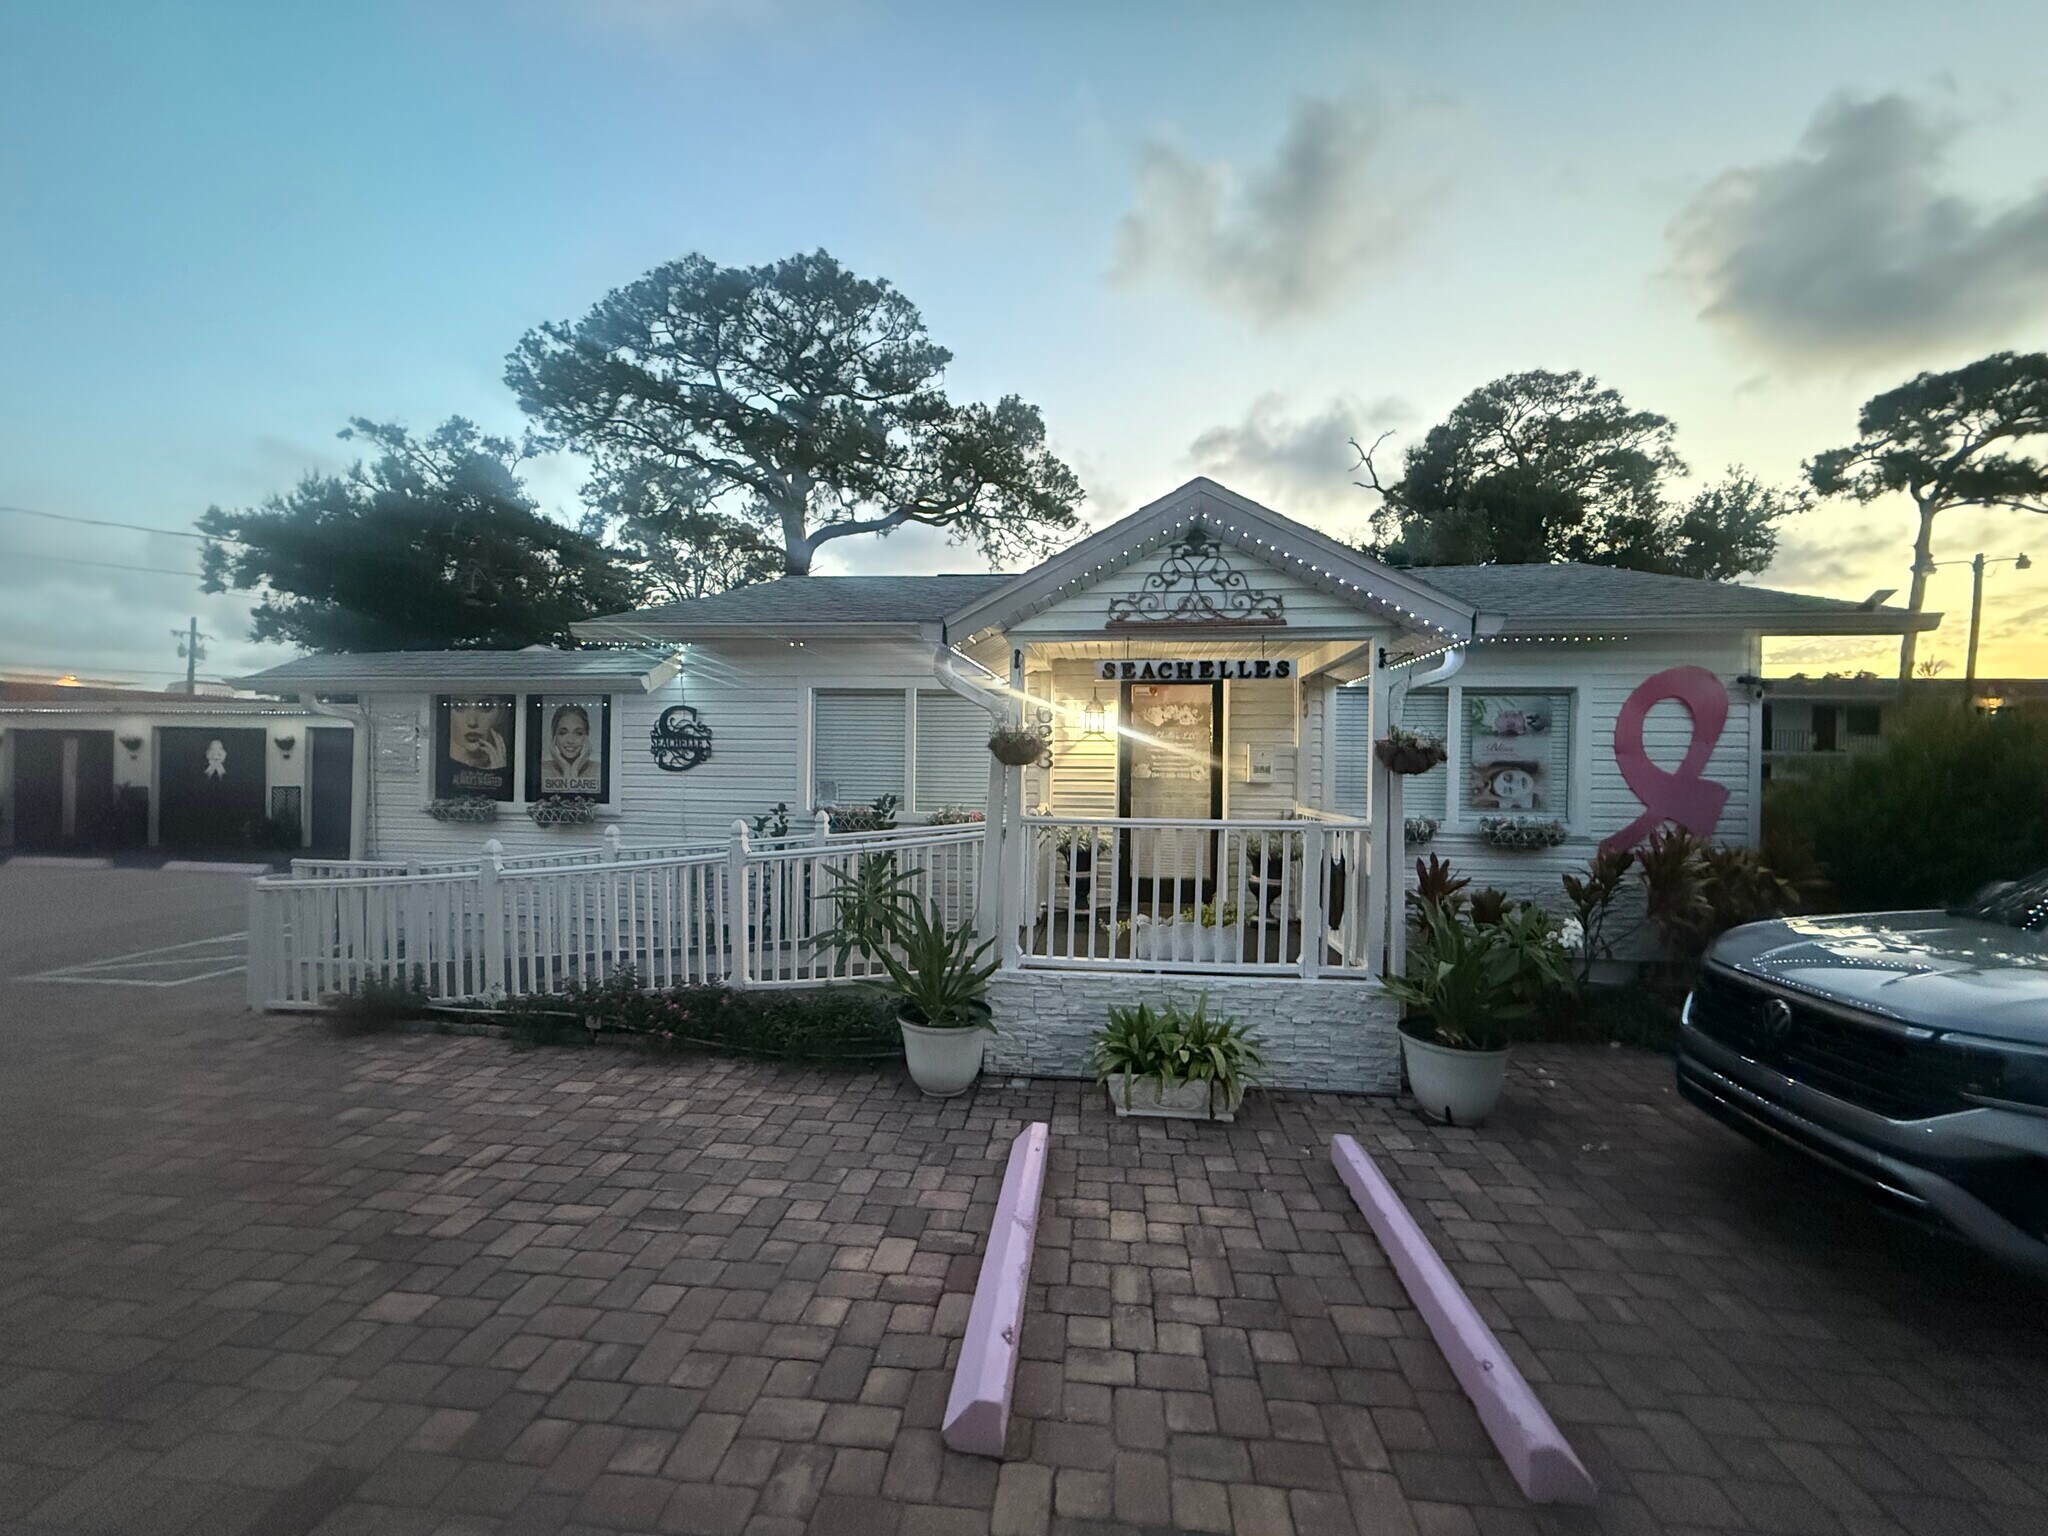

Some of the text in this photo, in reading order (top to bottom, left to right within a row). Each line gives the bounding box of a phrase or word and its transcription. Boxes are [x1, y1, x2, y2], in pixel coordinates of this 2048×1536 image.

[1102, 660, 1290, 680] SEACHELLES
[544, 779, 597, 790] SKIN CARE
